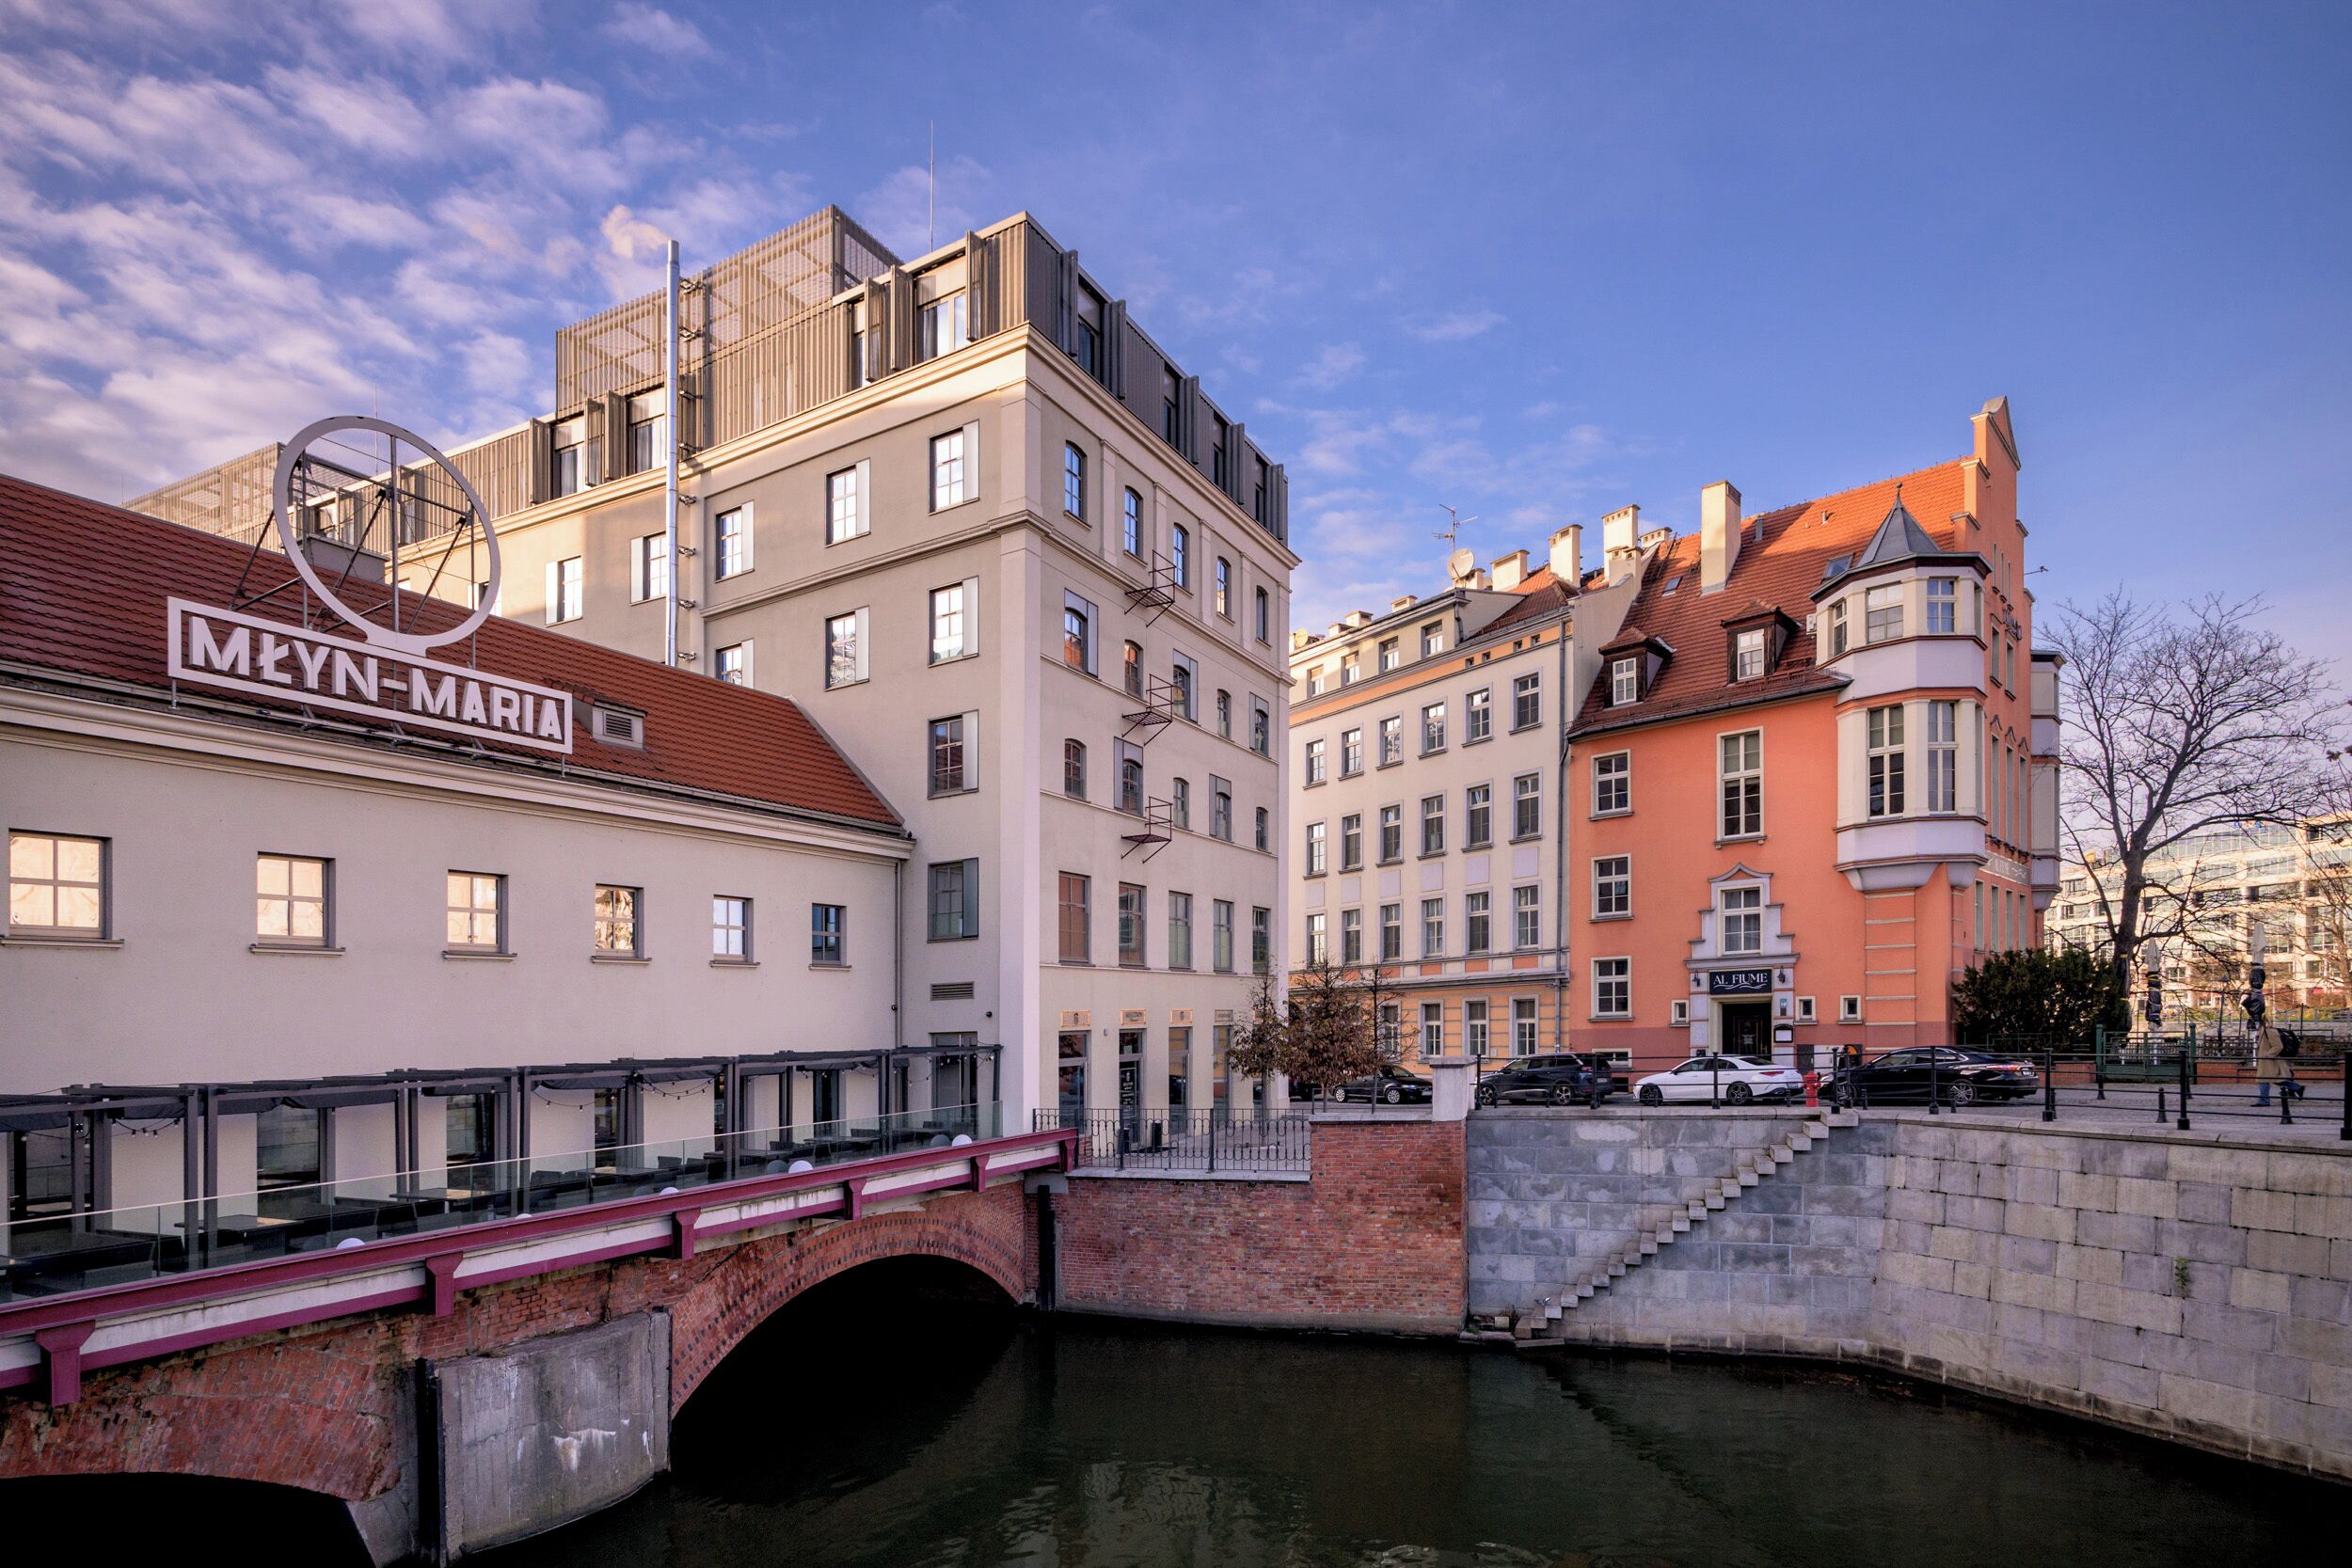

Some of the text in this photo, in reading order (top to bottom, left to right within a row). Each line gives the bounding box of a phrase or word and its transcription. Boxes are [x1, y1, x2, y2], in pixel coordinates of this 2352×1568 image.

[189, 616, 563, 740] MŁYN-MARIA
[1713, 973, 1768, 985] AL FIUME
